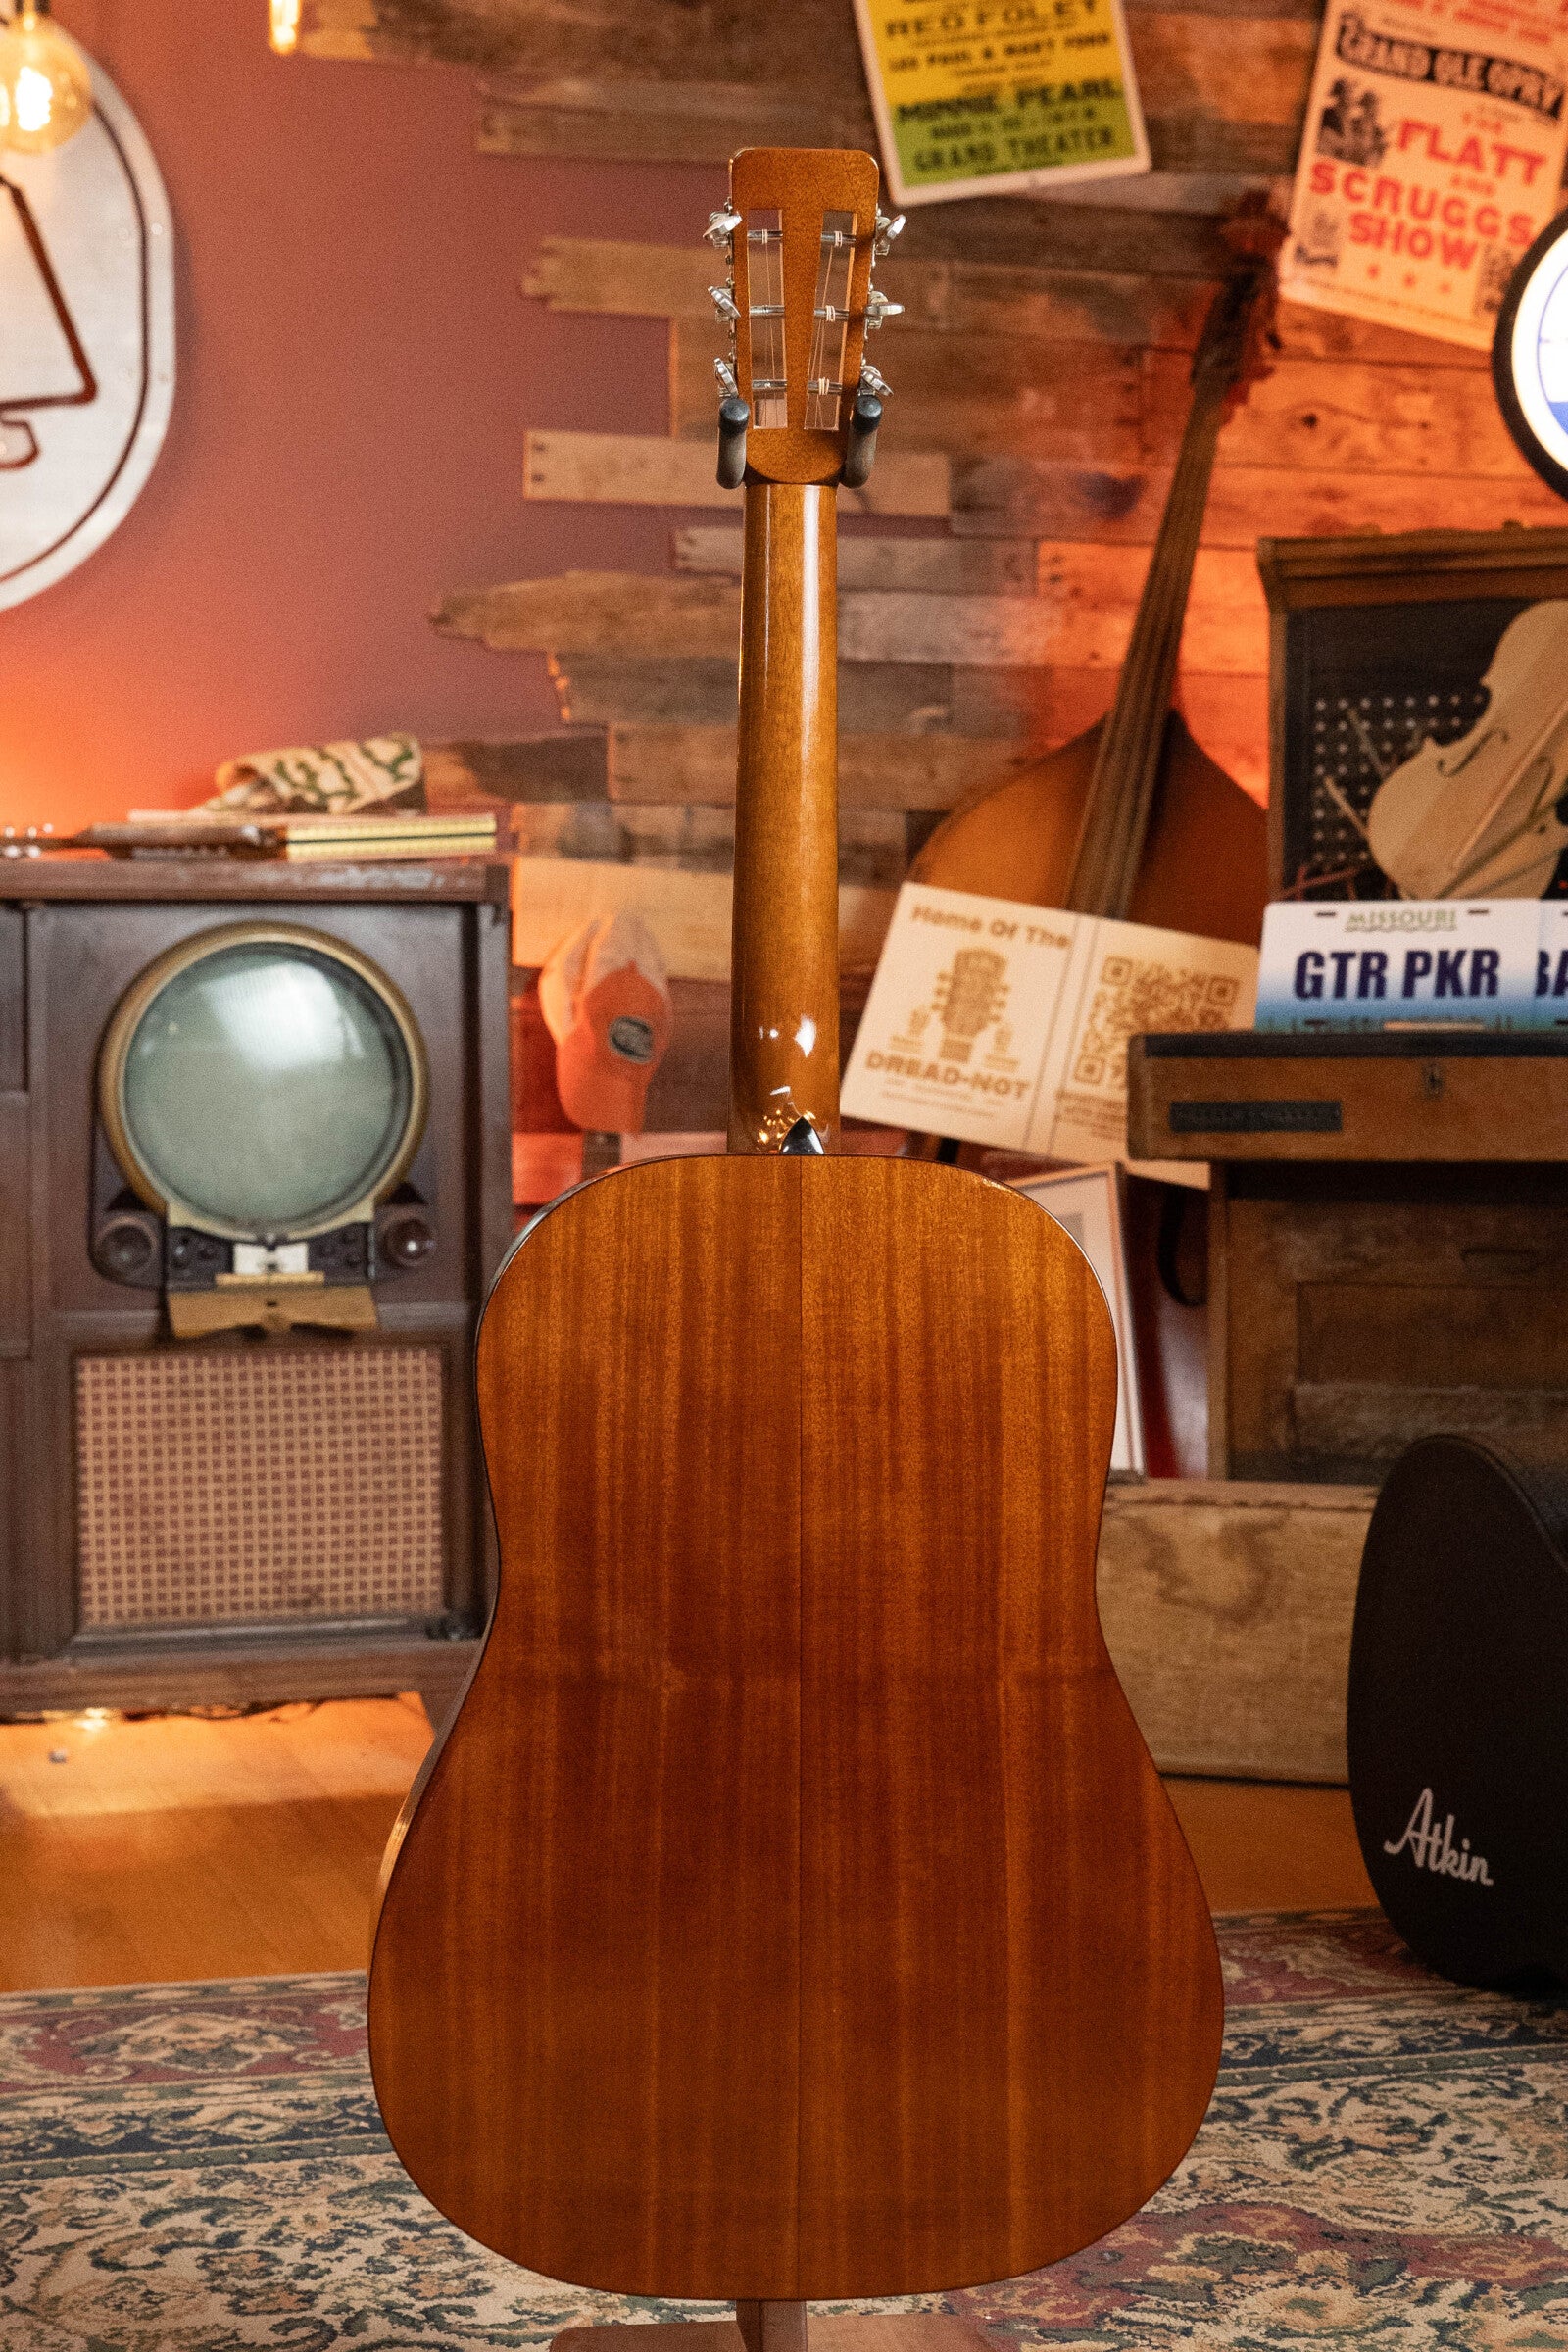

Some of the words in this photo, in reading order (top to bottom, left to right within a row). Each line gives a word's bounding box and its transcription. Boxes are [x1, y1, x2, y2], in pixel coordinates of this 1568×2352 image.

[1014, 77, 1125, 109] PEARL
[914, 140, 996, 172] GRAND
[1007, 126, 1114, 162] THEATER
[1397, 117, 1546, 186] FLATT
[1309, 160, 1535, 247] SCRUGGS
[1348, 211, 1478, 272] SHOW
[910, 906, 981, 933] Home
[1026, 925, 1071, 950] The
[1348, 908, 1457, 929] MISSOURI
[1294, 950, 1389, 1000] GTR
[1401, 949, 1500, 998] PKR
[865, 1050, 1030, 1100] DREAD-NOT
[1383, 1787, 1494, 1886] Atkin
